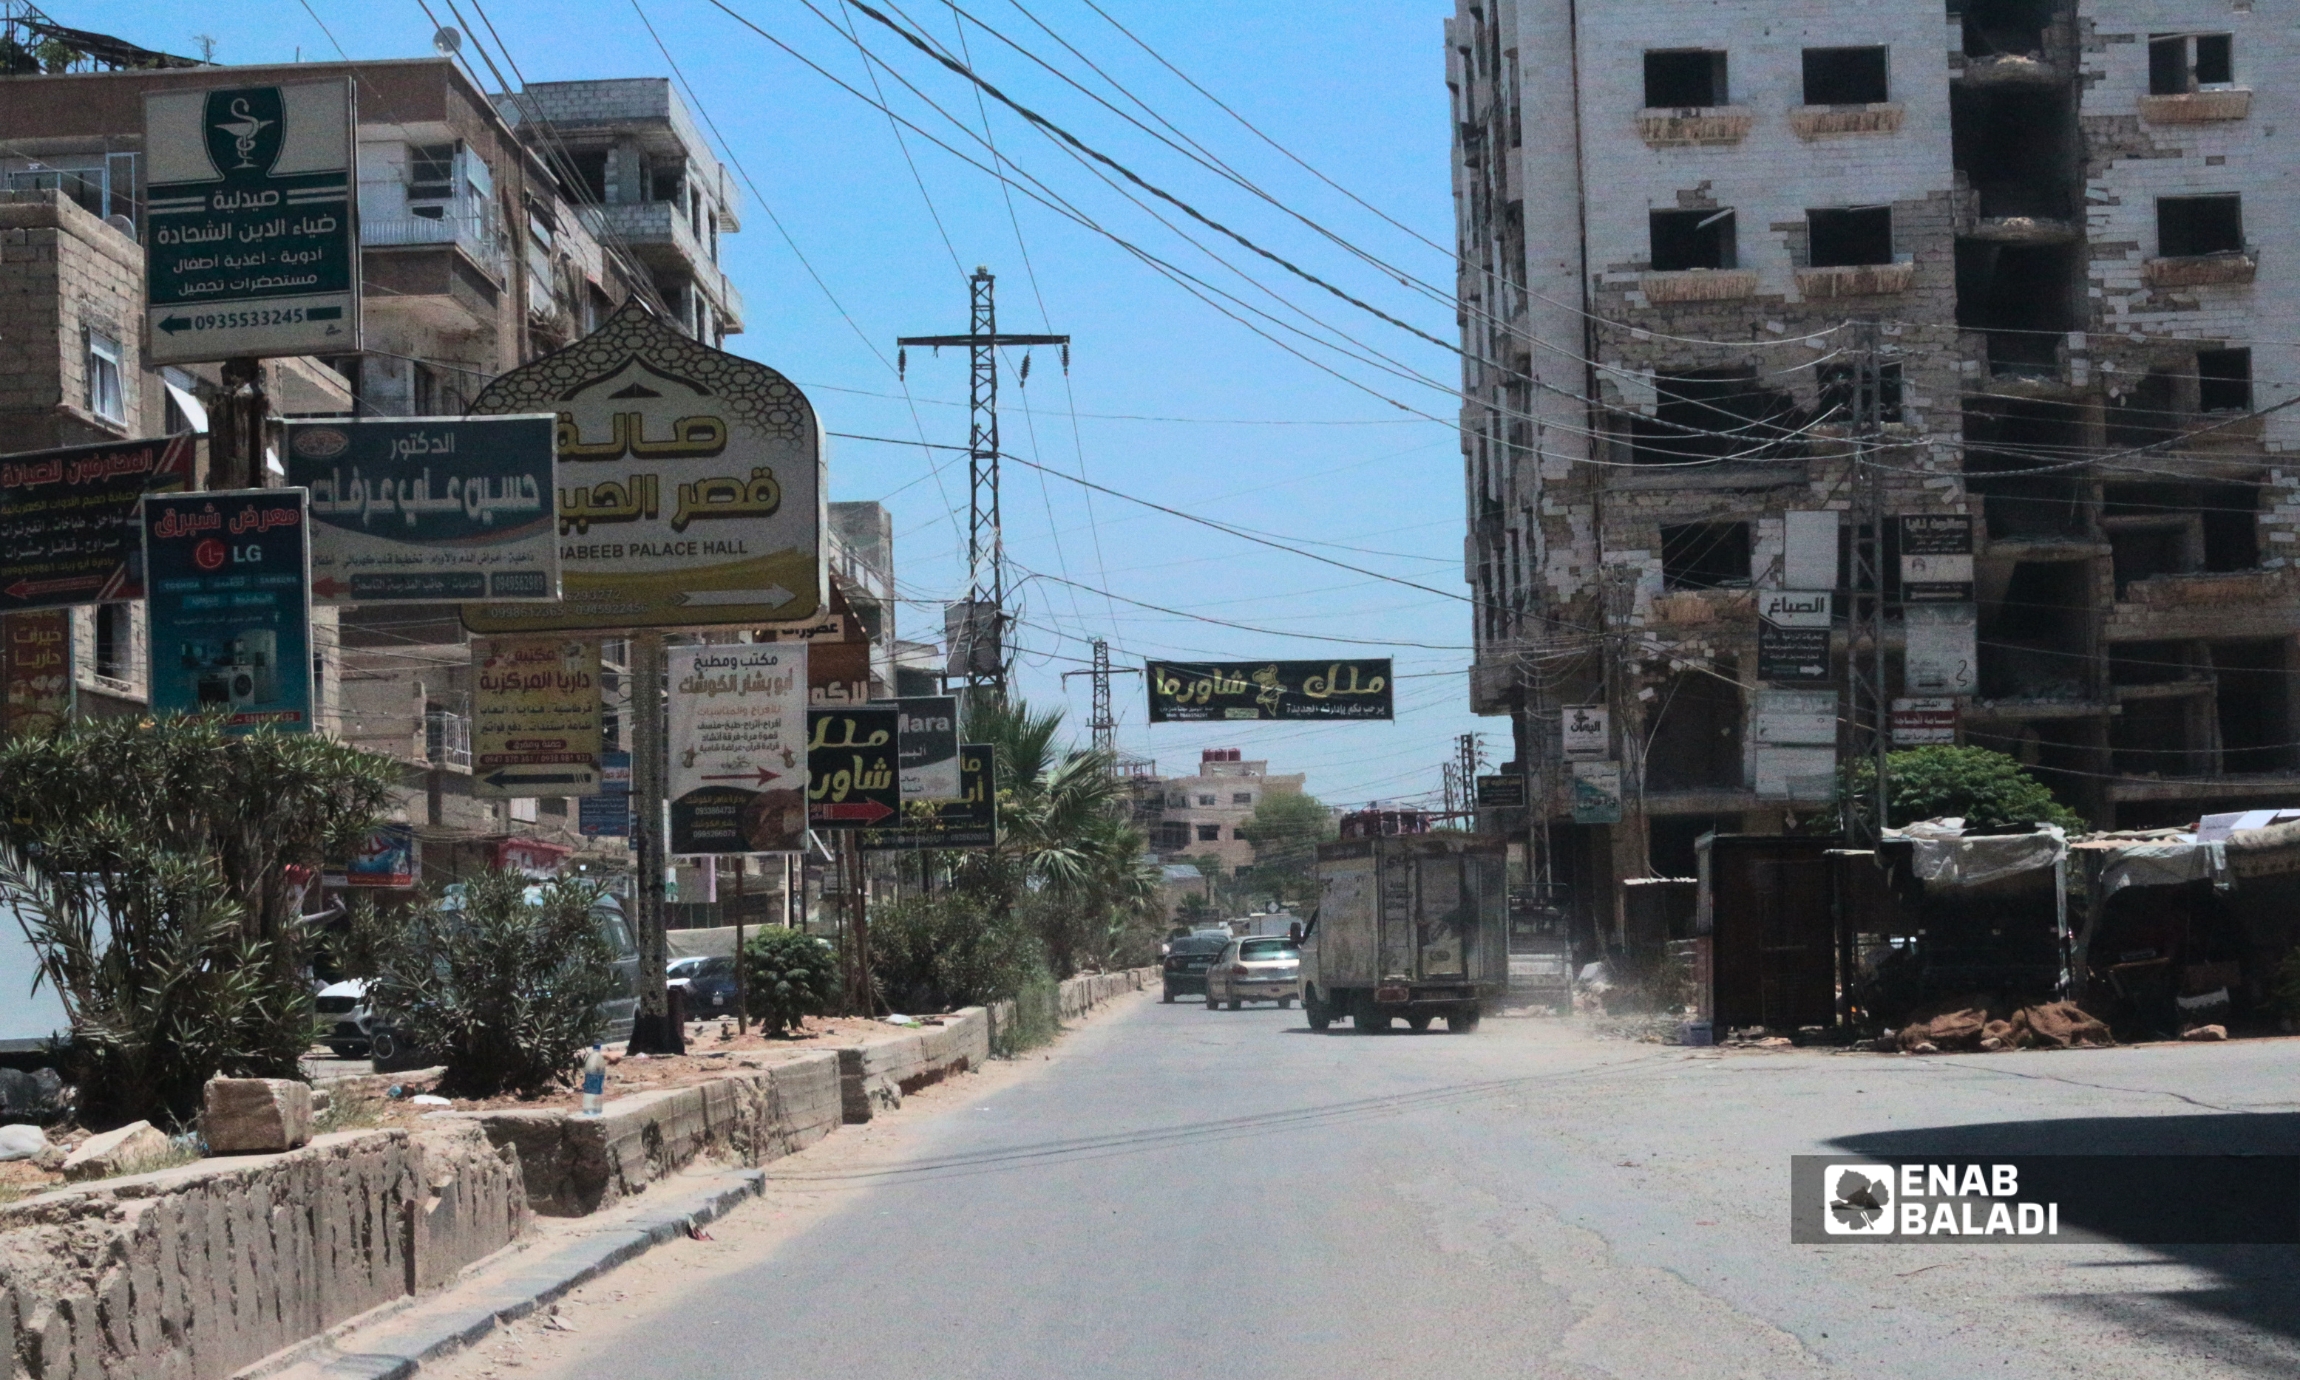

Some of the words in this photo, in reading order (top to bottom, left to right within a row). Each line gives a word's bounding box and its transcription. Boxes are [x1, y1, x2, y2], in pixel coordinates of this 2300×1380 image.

[213, 190, 280, 213] صيدلية
[158, 220, 231, 244] الشحادة
[239, 219, 285, 243] الدين
[293, 214, 336, 239] ضياء
[178, 280, 224, 296] تجميل
[230, 274, 317, 292] مستحضرات
[195, 308, 303, 330] 0935533245
[390, 431, 455, 461] الدكتور
[398, 466, 462, 527] علي
[464, 473, 541, 525] حسين
[558, 473, 660, 536] الحبي
[671, 466, 781, 534] قصر
[229, 504, 299, 534] معرض
[233, 544, 262, 563] LG
[630, 540, 698, 559] PALACE
[703, 539, 748, 555] HALL
[1768, 596, 1825, 618] الصباغ
[693, 653, 737, 671] ومطبخ
[740, 652, 779, 670] مكتب
[480, 671, 551, 695] المركزية
[557, 671, 591, 694] داريا
[774, 667, 794, 697] أبو
[1155, 666, 1248, 704] شاورما
[1303, 663, 1385, 699] ملك
